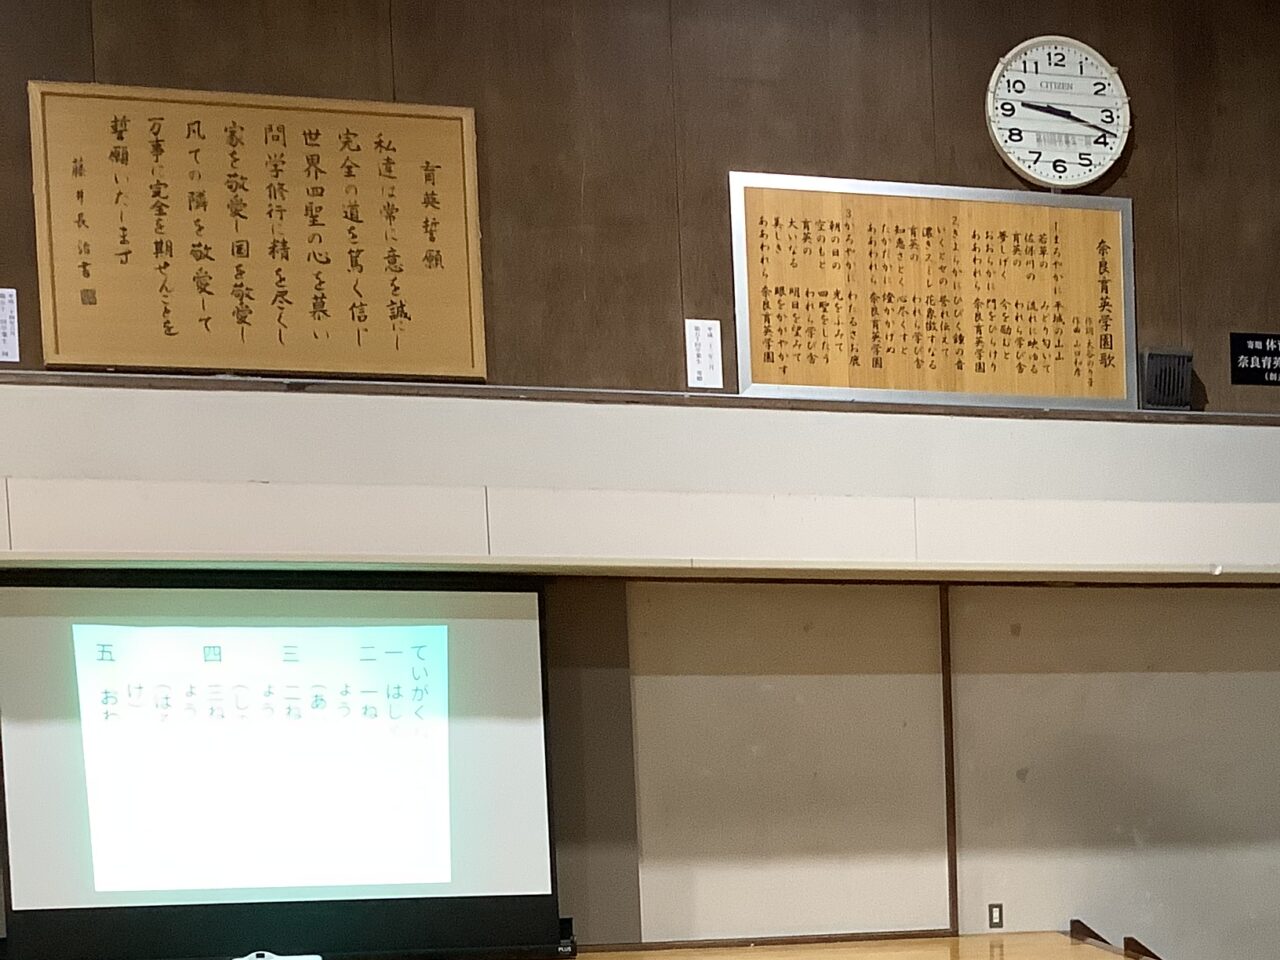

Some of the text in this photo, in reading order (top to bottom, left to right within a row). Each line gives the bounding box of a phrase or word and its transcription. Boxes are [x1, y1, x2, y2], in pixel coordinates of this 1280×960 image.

[1047, 52, 1066, 67] 12
[1022, 61, 1039, 74] 11
[1079, 61, 1083, 75] 1
[1006, 79, 1026, 93] 10
[1040, 81, 1074, 91] CITIZEN
[1093, 82, 1106, 96] 2
[1000, 102, 1015, 117] 9
[1101, 109, 1115, 124] 3
[1008, 128, 1023, 142] 8
[1094, 134, 1109, 147] 4
[1028, 151, 1042, 165] 7
[1079, 153, 1092, 167] 5
[1053, 159, 1067, 174] 6
[108, 115, 133, 265] 誓願いたします
[421, 160, 444, 269] 育英誓願
[303, 128, 331, 339] 世界四聖の心を慕い
[1096, 238, 1115, 369] 奈良育英学園歌
[761, 285, 775, 363] 奈良育英学園
[96, 643, 116, 662] 五
[203, 645, 222, 662] 四
[282, 645, 301, 662] 三
[359, 646, 378, 662] 二
